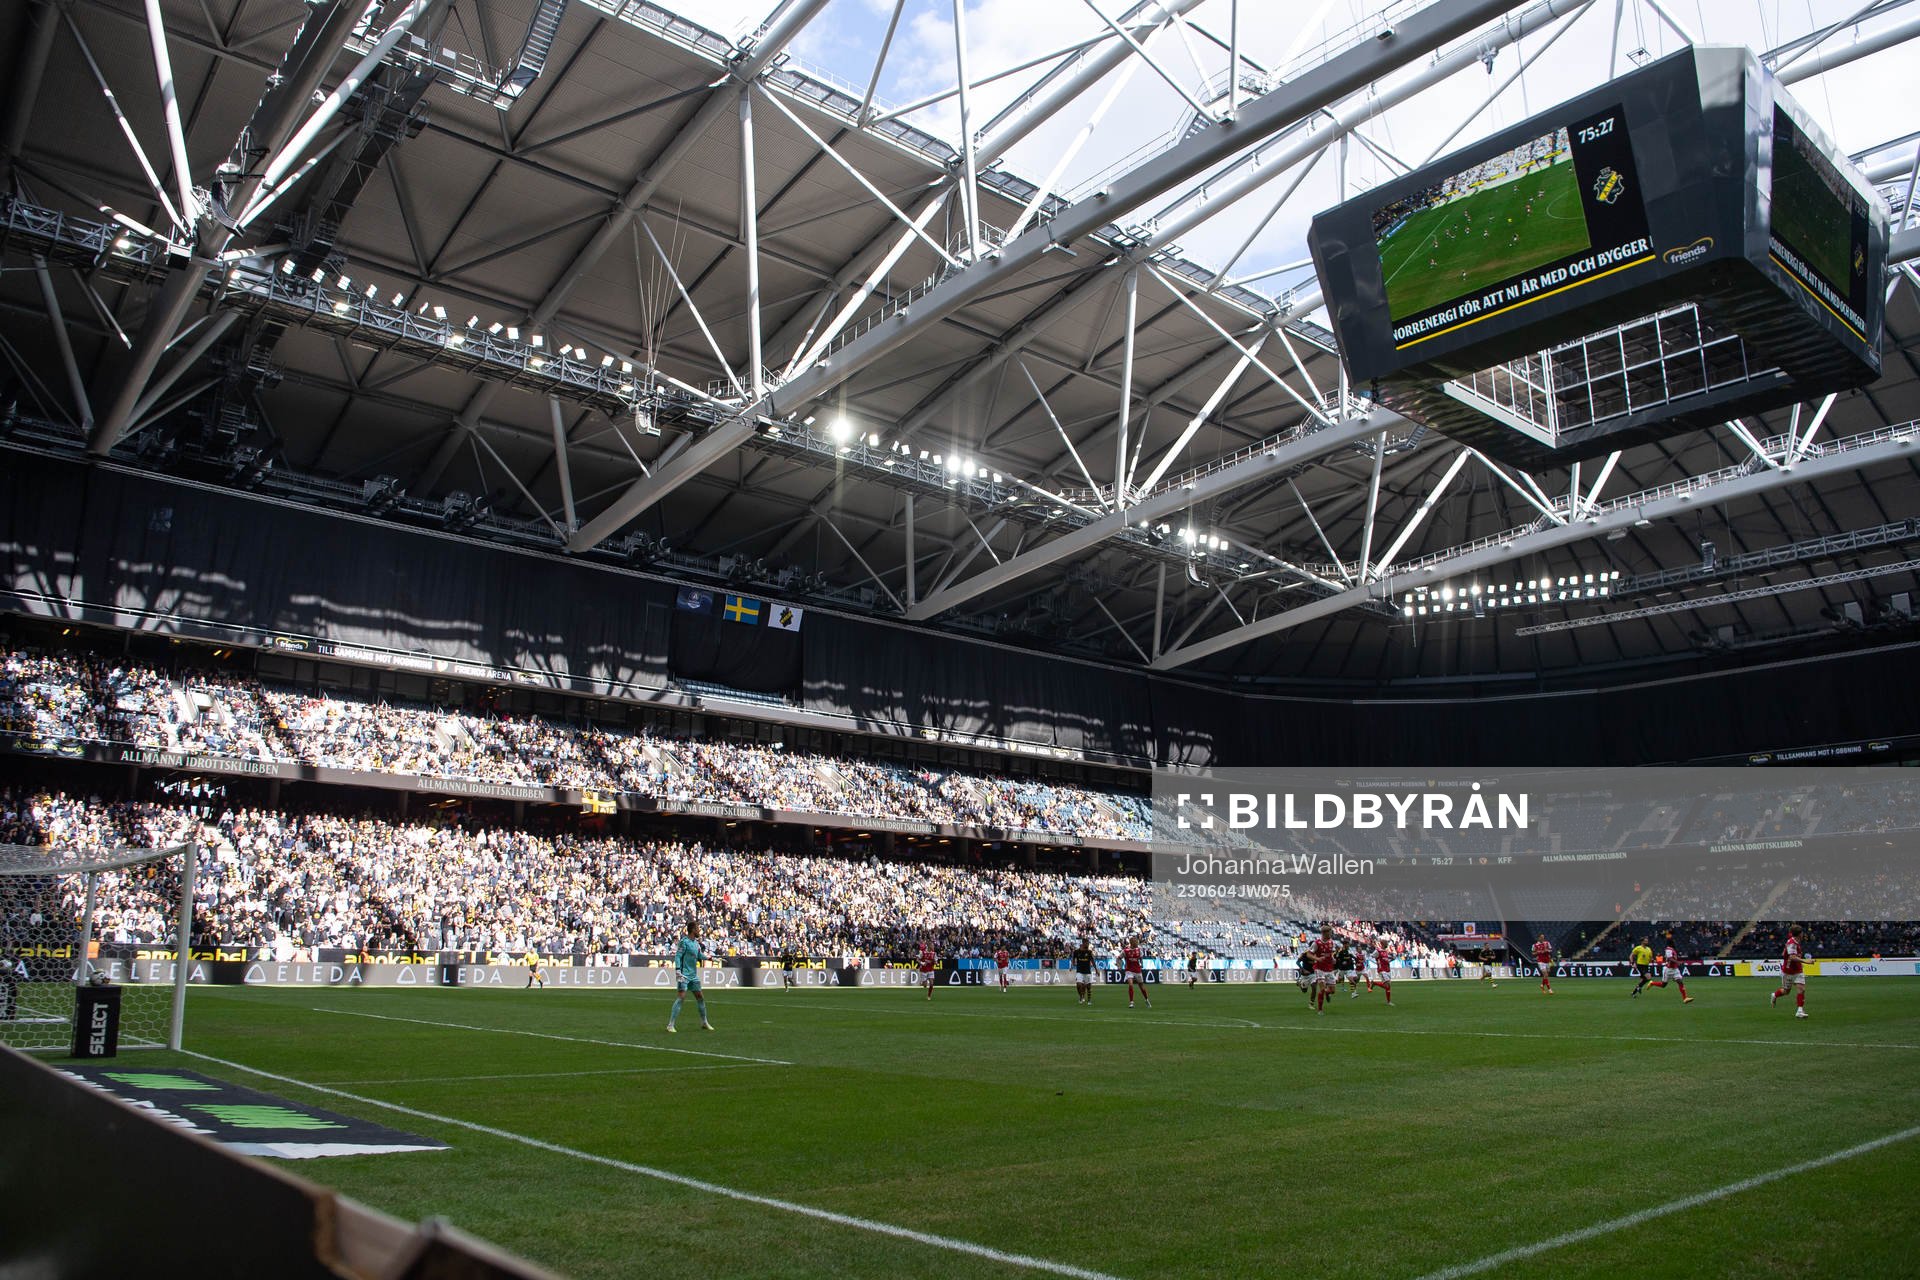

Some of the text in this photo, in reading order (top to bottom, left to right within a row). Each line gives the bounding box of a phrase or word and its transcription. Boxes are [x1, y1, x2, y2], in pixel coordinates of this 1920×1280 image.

[1578, 117, 1615, 144] 75:27
[1670, 244, 1707, 264] friends
[1393, 238, 1649, 341] NORRENERGI FÖR ATT NI ÄR MED OCH BYGGER
[280, 641, 304, 651] friends
[486, 667, 512, 681] ARENA
[120, 750, 279, 776] ALLMÄNNA IDROTTSKLUBBEN
[417, 778, 545, 799] ALLMÄNNA IDROTTSKLUBBEN
[656, 801, 760, 819] ALLMÄNNA IDROTTSKLUBBEN
[851, 818, 937, 833] ALLMÄNNA IDROTTSKLUBBEN
[1710, 839, 1803, 853] ALLMÄNNA IDROTTSKLUBBEN
[1376, 856, 1513, 865] AIK 0 75:27 1 KFF
[1542, 851, 1627, 863] ALLMÄNNA IDROTTSKLUBBEN
[760, 958, 827, 970] amkabel
[1853, 964, 1877, 972] Ocab
[277, 965, 363, 982] ELEDA
[426, 967, 503, 983] ELEDA
[559, 969, 627, 984] ELEDA
[703, 971, 739, 984] EDA
[796, 971, 840, 984] LEDA
[880, 971, 918, 984] ELED
[1159, 970, 1187, 981] ELED
[1220, 970, 1253, 981] ELEDA
[1500, 967, 1541, 977] ELEDA
[1570, 967, 1614, 977] ELEDA
[89, 1002, 109, 1055] SELECT
